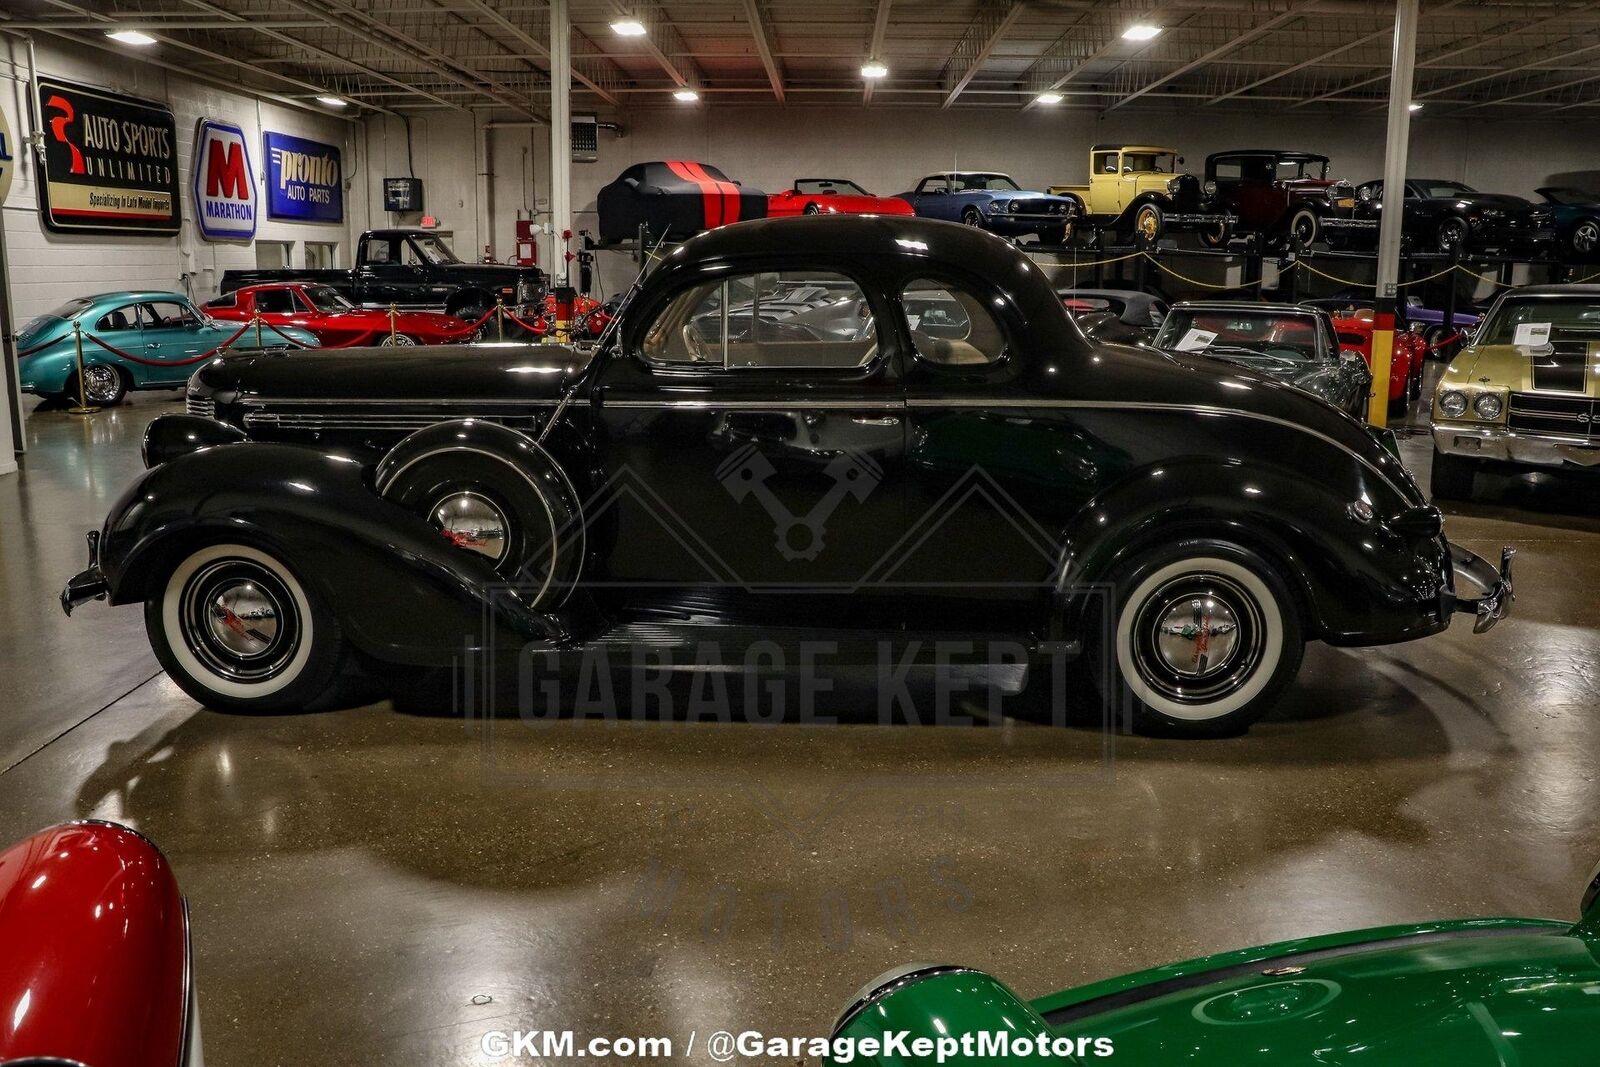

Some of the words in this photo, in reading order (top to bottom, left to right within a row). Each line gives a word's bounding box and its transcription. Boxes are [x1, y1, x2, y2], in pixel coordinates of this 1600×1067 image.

[83, 113, 119, 152] AUTO
[122, 121, 170, 160] SPORTS
[86, 157, 171, 184] UNLIMITED
[206, 138, 249, 200] M
[280, 150, 338, 189] pronto
[89, 192, 120, 209] Specializing
[127, 196, 137, 209] Late
[287, 185, 305, 200] AUTO
[308, 189, 330, 204] PARTS
[206, 201, 252, 220] MARATHON
